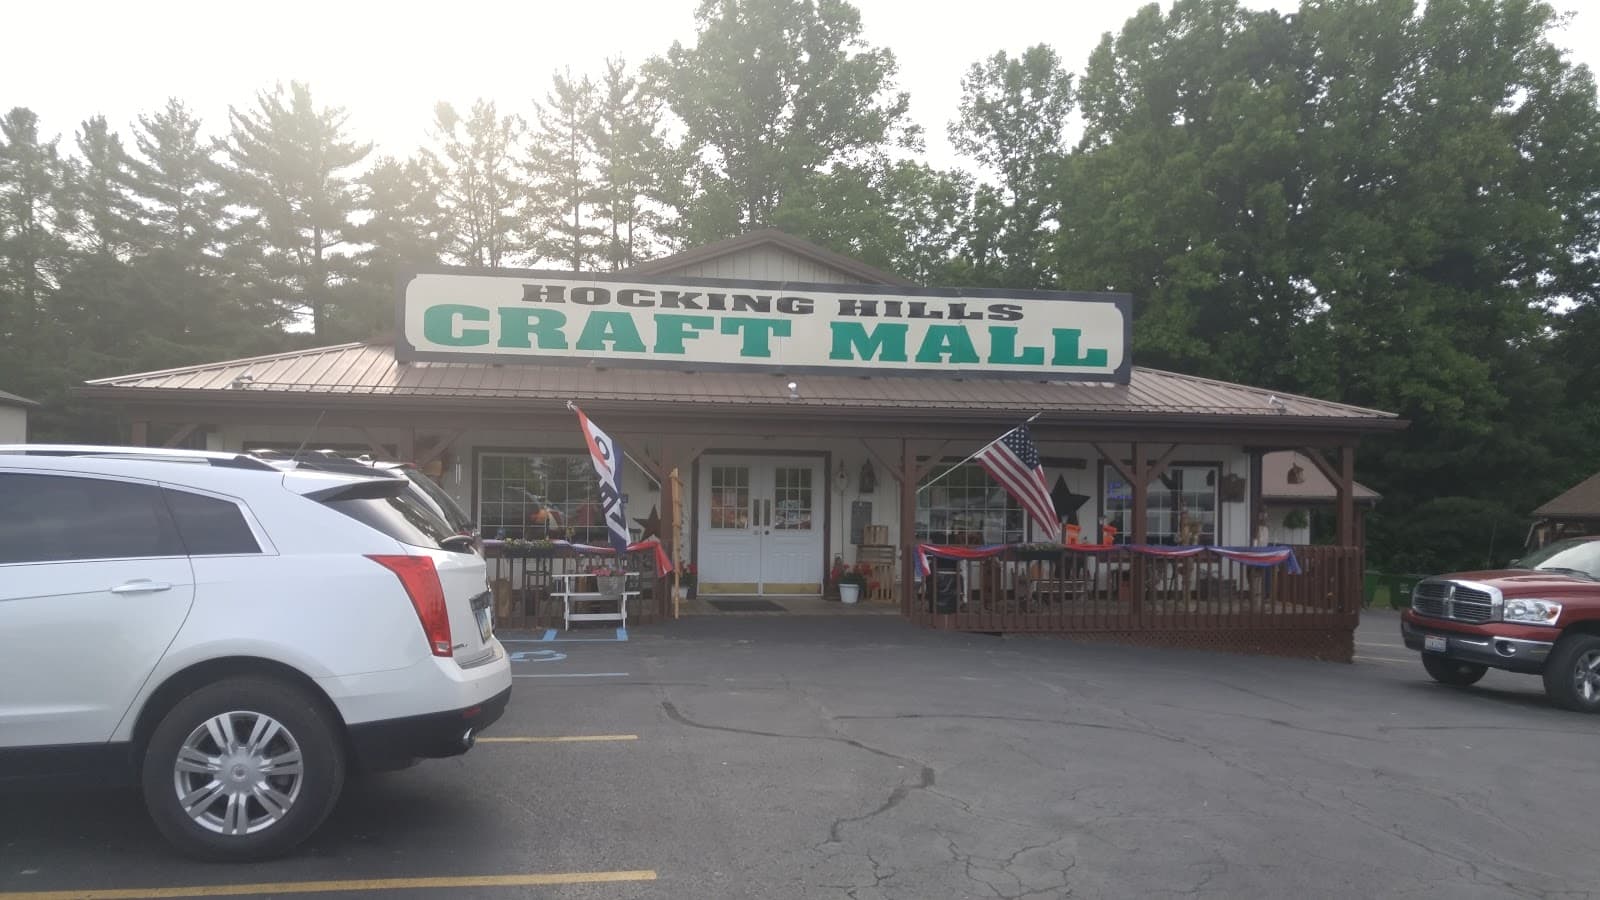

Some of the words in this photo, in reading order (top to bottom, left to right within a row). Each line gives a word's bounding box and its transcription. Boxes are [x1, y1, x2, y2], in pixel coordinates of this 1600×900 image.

[522, 284, 814, 314] HOCKING
[838, 299, 1024, 321] HILLS
[423, 304, 791, 358] CRAFT
[829, 321, 1107, 367] MALL
[594, 435, 627, 531] OEN
